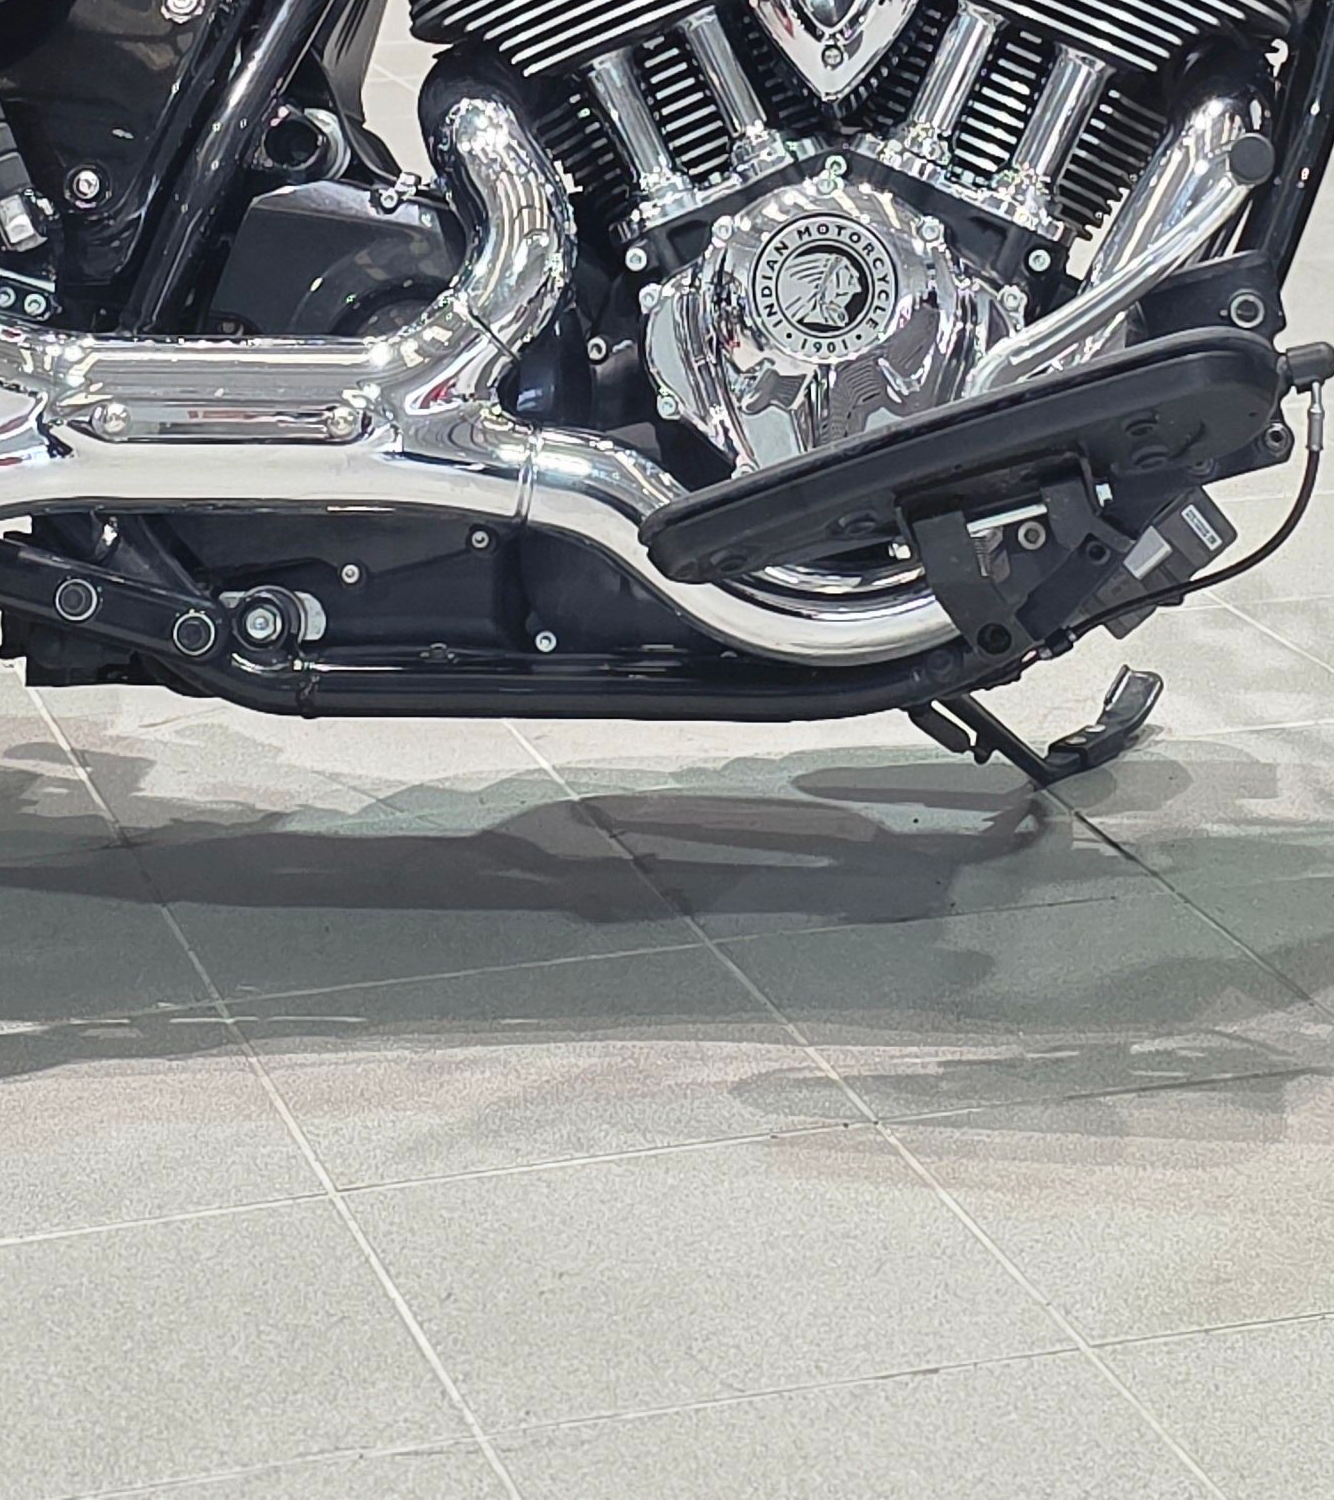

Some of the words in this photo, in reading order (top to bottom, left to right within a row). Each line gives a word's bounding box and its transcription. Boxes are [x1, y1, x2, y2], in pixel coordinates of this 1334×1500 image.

[761, 240, 789, 328] INDIAN
[797, 223, 890, 330] MOTORCYCLE
[801, 338, 848, 353] 1901
